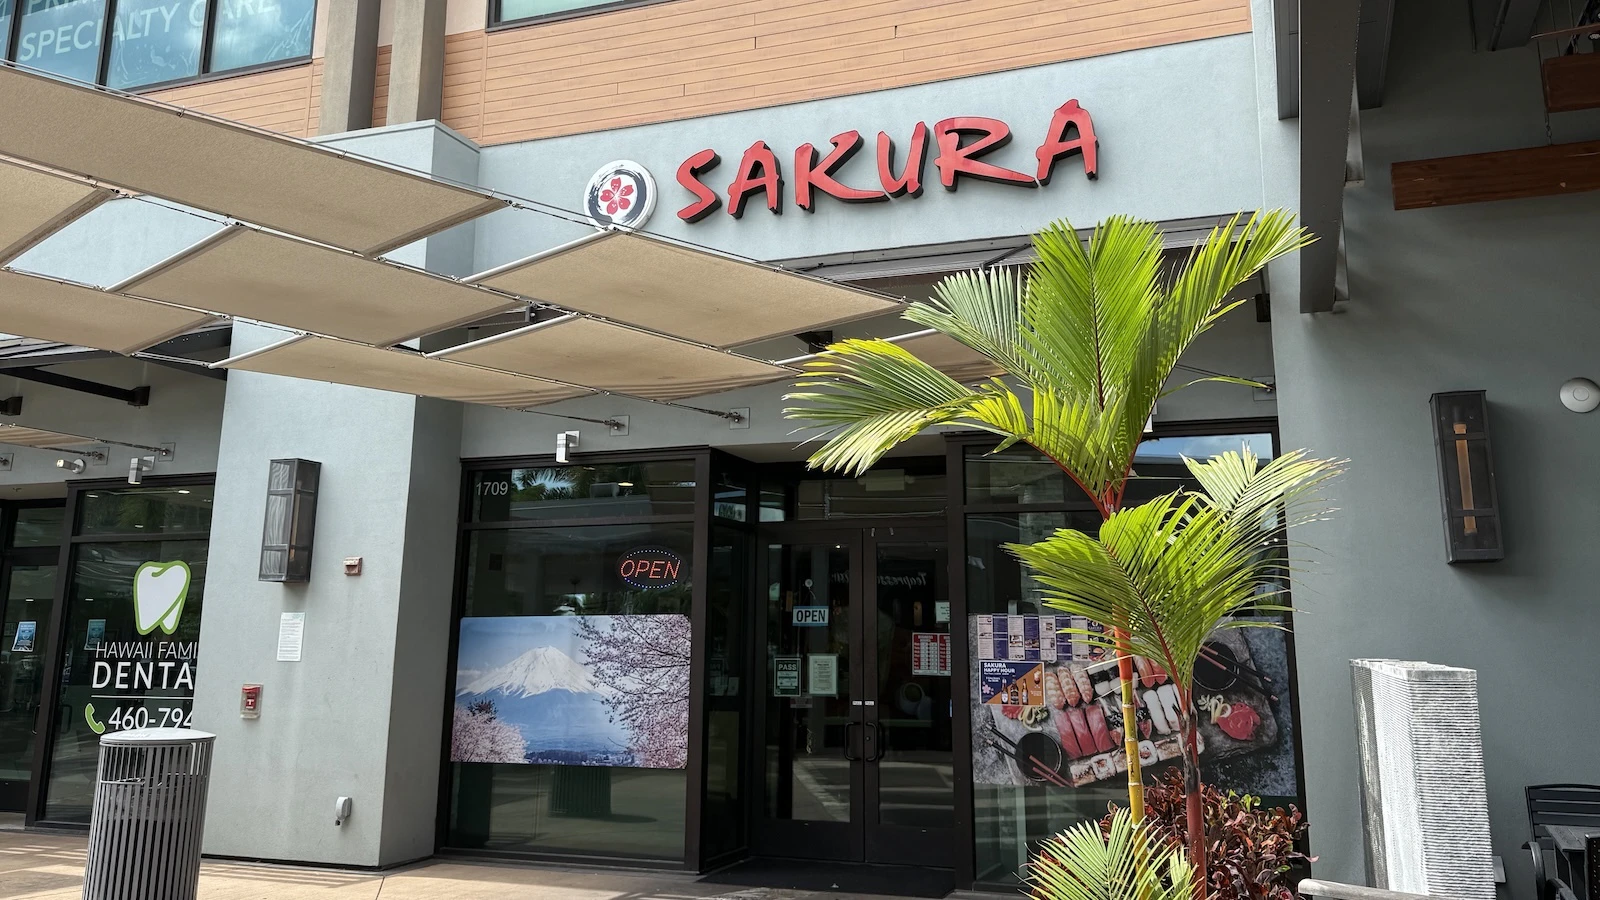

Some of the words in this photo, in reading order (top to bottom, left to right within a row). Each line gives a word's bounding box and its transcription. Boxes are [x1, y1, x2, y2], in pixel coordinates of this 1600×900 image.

[19, 3, 181, 61] SPECIALTY
[676, 98, 1099, 223] SAKURA
[475, 481, 509, 496] 1709
[620, 559, 681, 579] OPEN
[796, 609, 826, 623] OPEN
[95, 641, 153, 659] HAWAII
[157, 641, 198, 659] FAMI
[91, 661, 194, 690] DENTA
[778, 663, 797, 671] PASS
